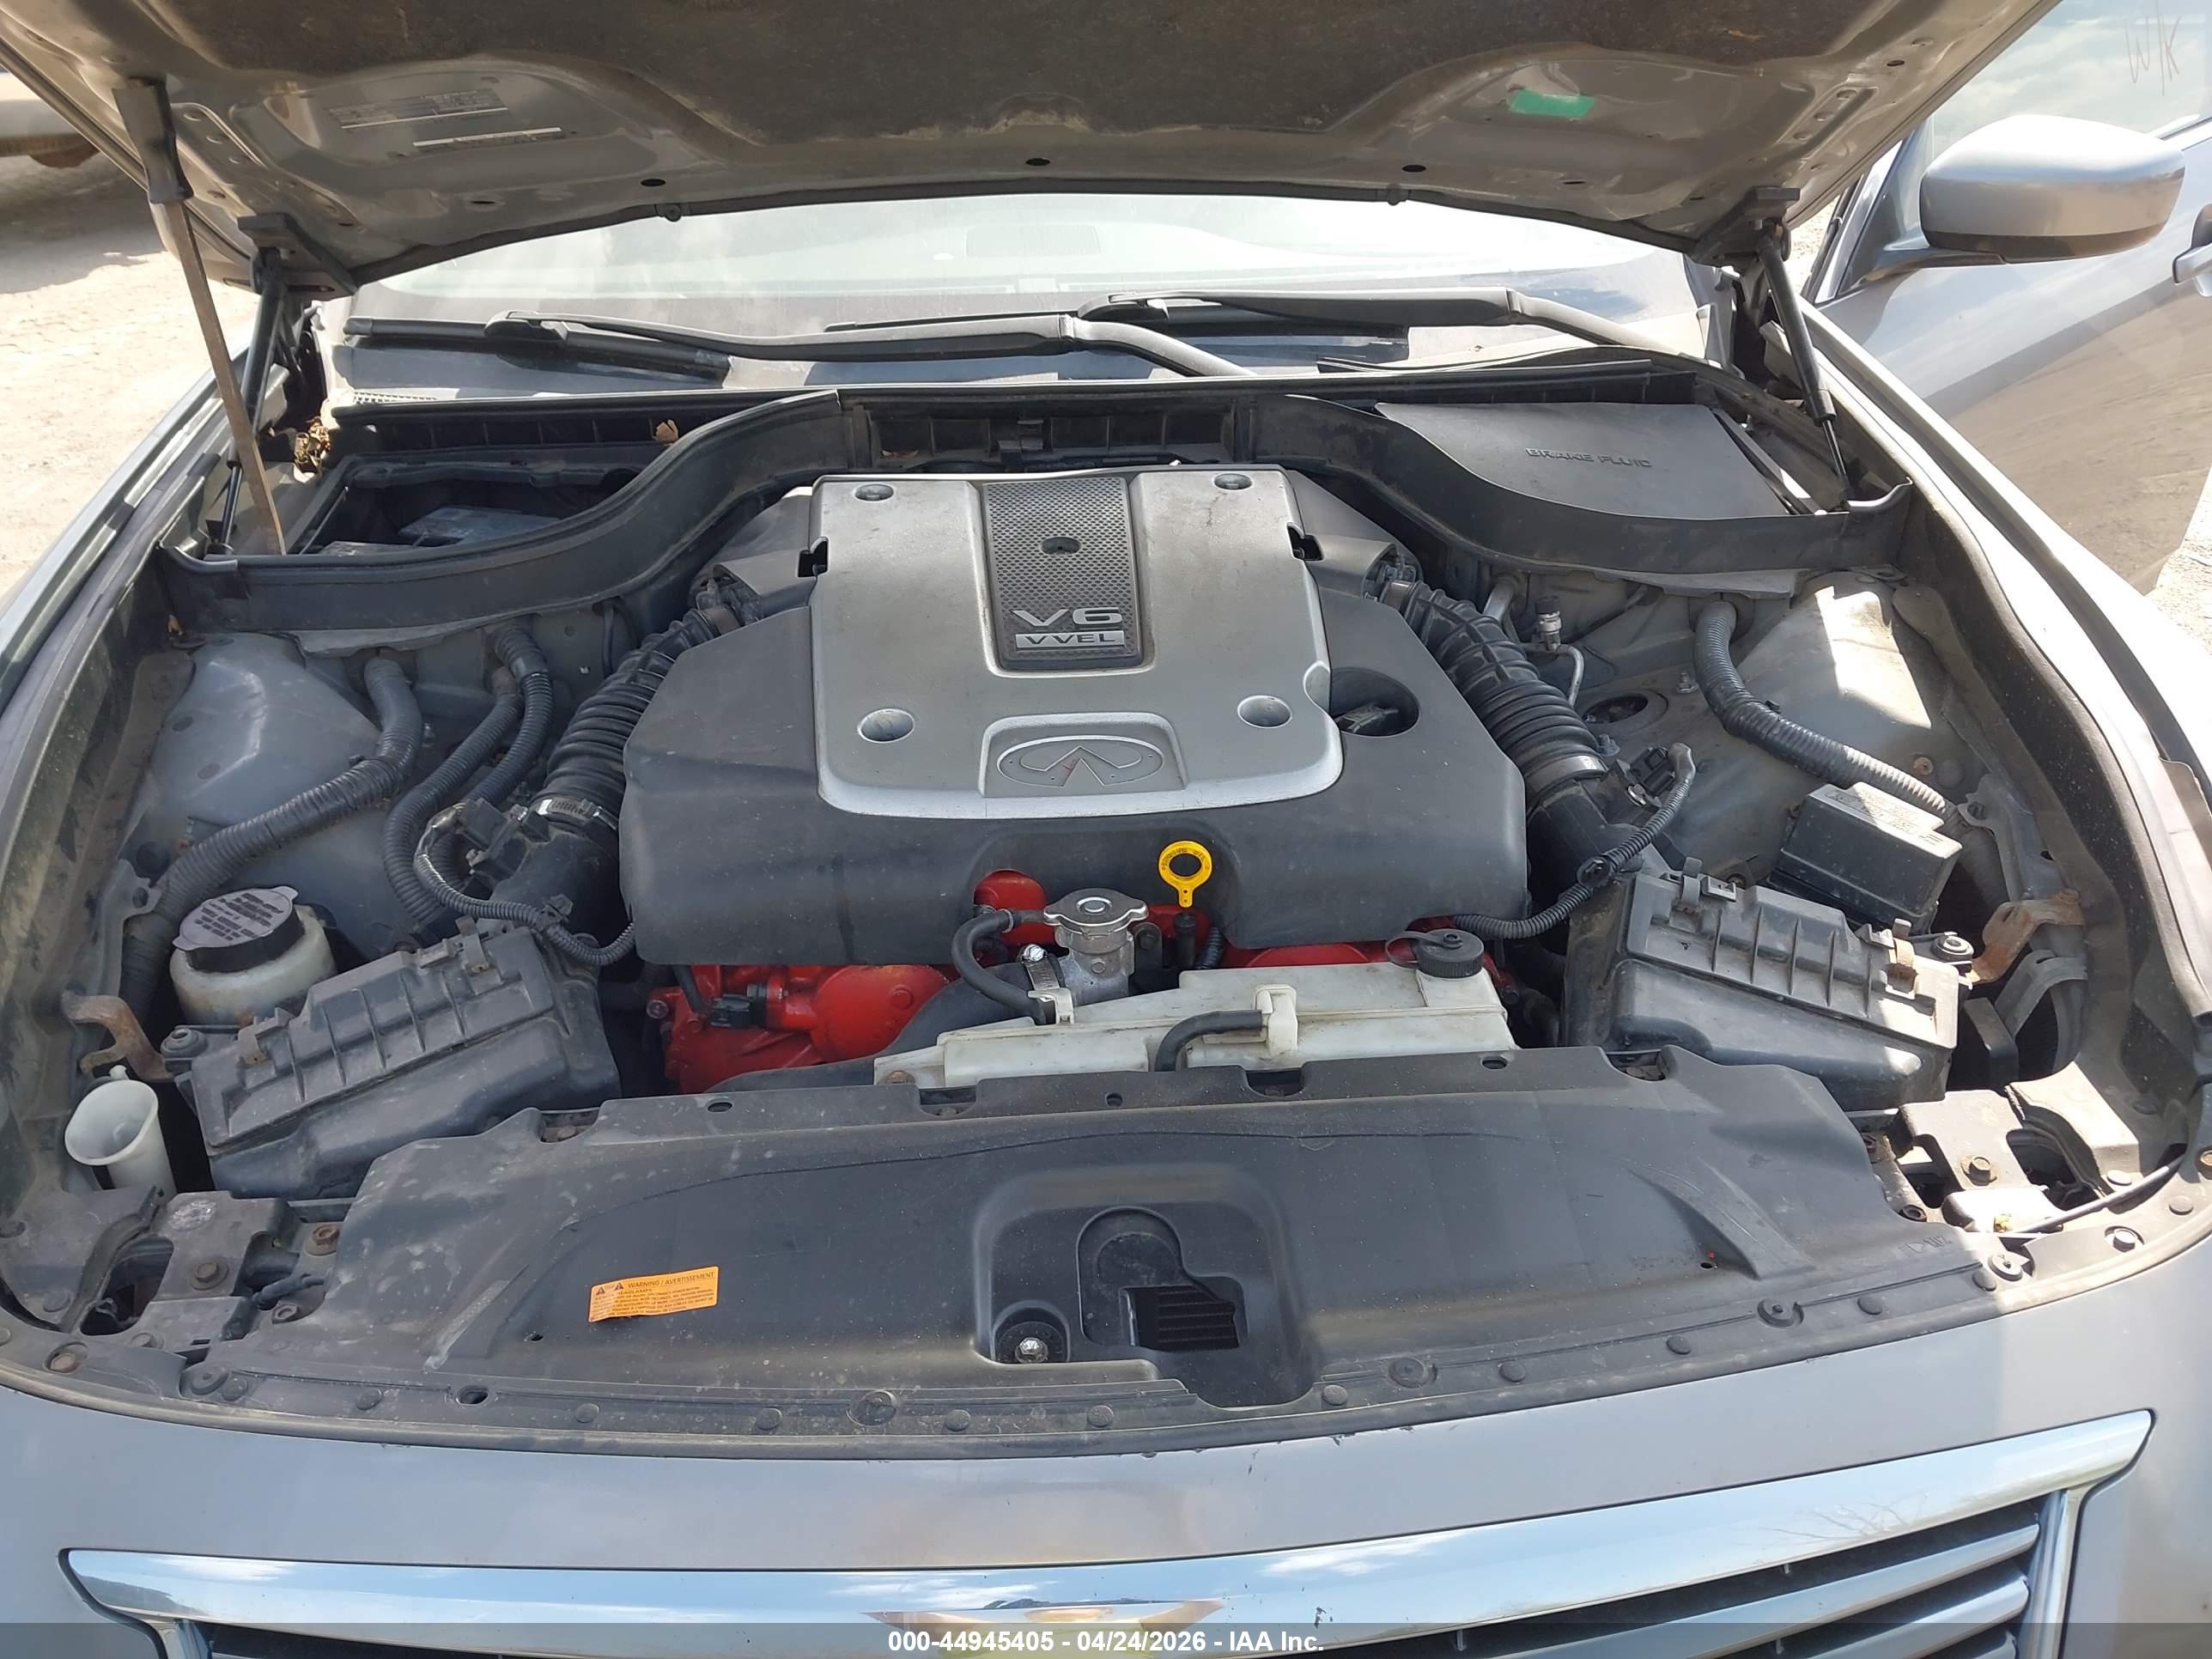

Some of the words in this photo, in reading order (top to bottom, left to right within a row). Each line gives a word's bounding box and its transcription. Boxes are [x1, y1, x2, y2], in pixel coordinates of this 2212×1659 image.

[1525, 447, 1595, 462] BRAKE
[1010, 606, 1123, 627] V6
[1024, 633, 1115, 645] VVEL
[628, 1279, 659, 1289] WARNING
[665, 1272, 714, 1285] AVERTISSEMENT
